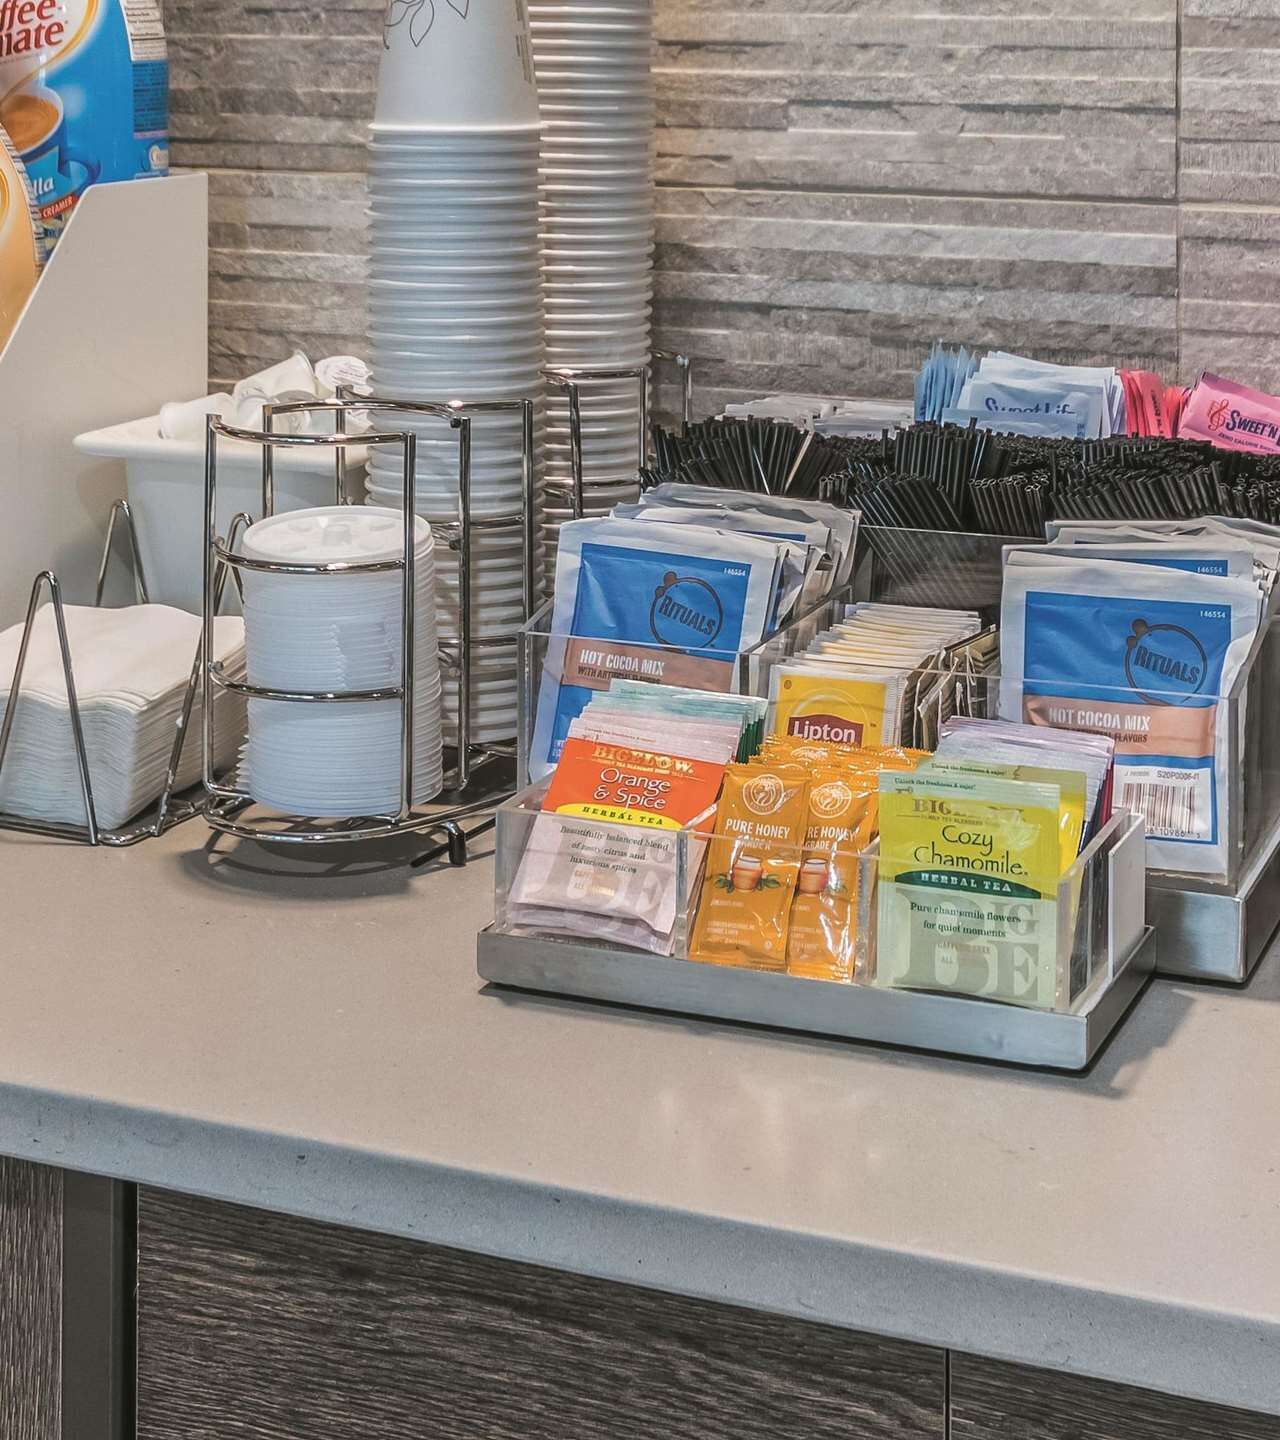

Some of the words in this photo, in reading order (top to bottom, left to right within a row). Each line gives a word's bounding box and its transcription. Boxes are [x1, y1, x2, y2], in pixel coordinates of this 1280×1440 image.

[658, 594, 717, 636] RITUALS
[579, 648, 606, 667] HOT
[606, 652, 640, 673] COCOA
[640, 658, 666, 677] MIX
[1133, 645, 1201, 685] RITUALS
[1048, 707, 1074, 725] HOT
[1076, 710, 1121, 730] COCOA
[1124, 715, 1151, 732] MIX
[793, 720, 856, 742] Lipton
[600, 767, 672, 797] Orange
[593, 784, 610, 800] &
[613, 787, 667, 809] Spice
[581, 806, 633, 821] HERBAL
[639, 815, 664, 826] TEA
[724, 818, 753, 835] PURE
[755, 823, 791, 840] HONEY
[820, 825, 857, 842] HONEY
[644, 837, 670, 852] blend
[806, 840, 830, 850] GRADE
[941, 824, 994, 857] Cozy
[603, 847, 628, 858] citrus
[628, 850, 646, 861] and
[609, 863, 638, 874] spices
[920, 872, 978, 888] HERBAL
[983, 880, 1012, 893] TEA
[910, 901, 932, 913] Pure
[933, 905, 985, 919] chamomile
[986, 912, 1022, 923] flowers
[923, 919, 936, 930] for
[937, 922, 961, 935] quiet
[962, 927, 1007, 938] moments
